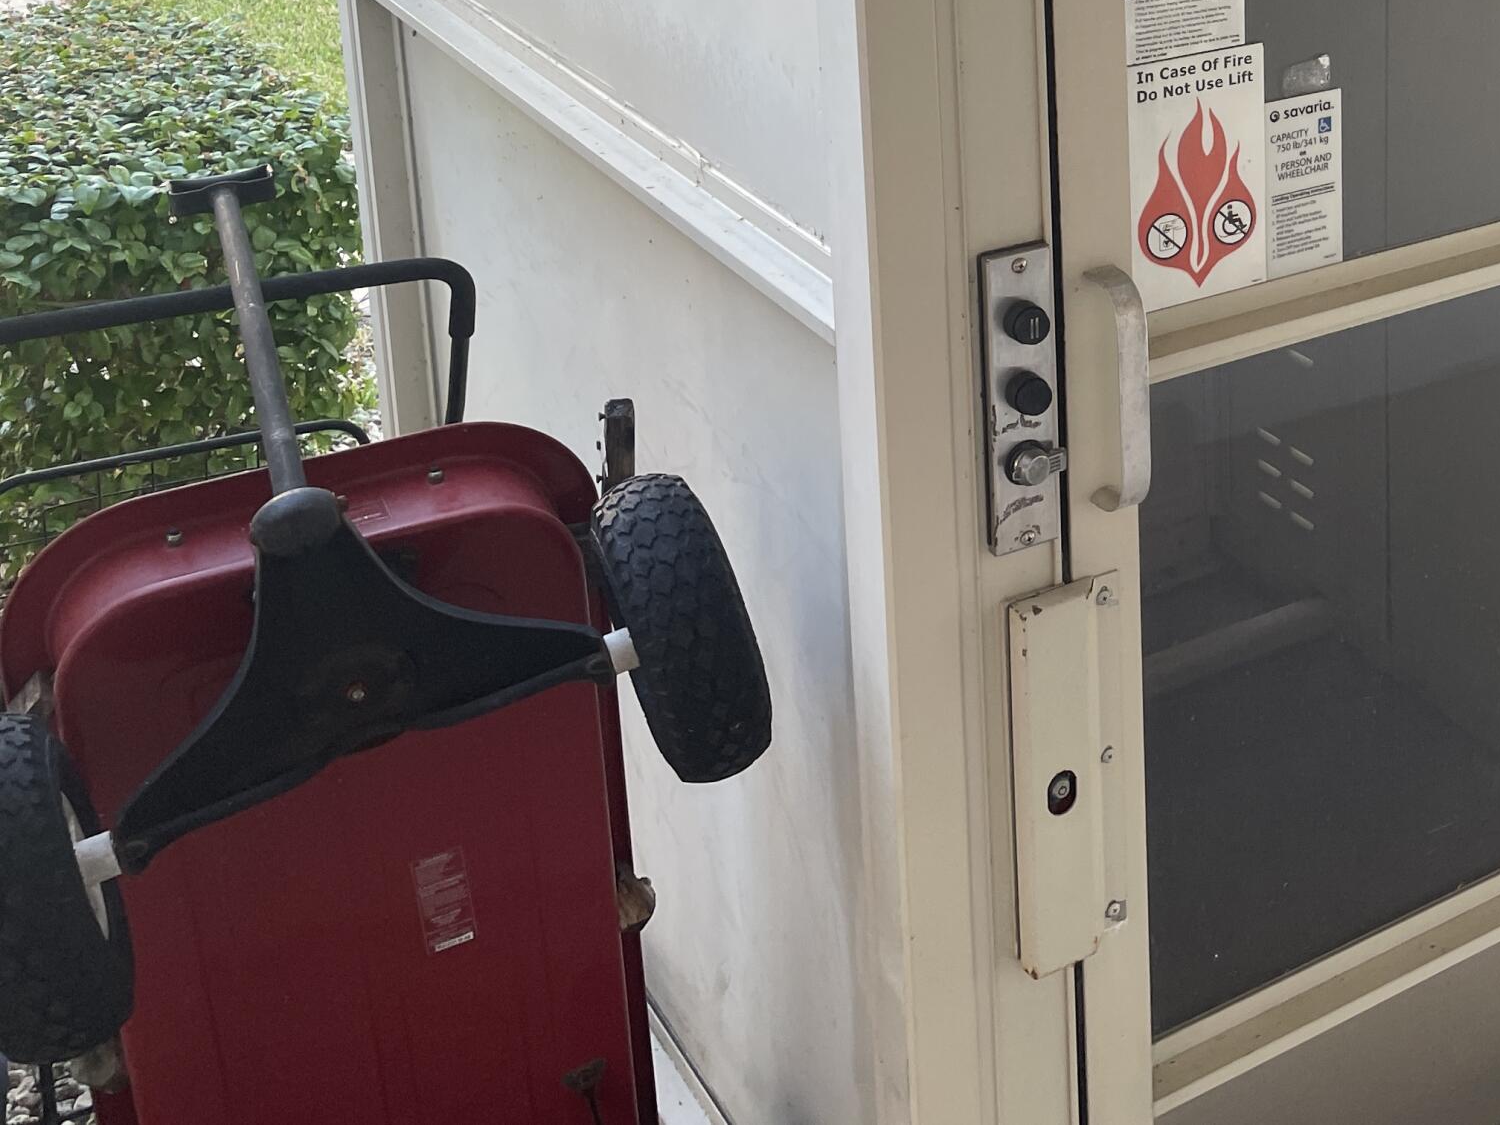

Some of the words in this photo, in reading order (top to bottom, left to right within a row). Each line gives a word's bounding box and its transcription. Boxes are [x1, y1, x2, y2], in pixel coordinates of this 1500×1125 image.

[1136, 71, 1154, 84] In
[1160, 65, 1196, 80] Case
[1202, 58, 1219, 72] Of
[1224, 55, 1252, 68] Fire
[1137, 90, 1158, 103] Do
[1163, 82, 1191, 98] Not
[1195, 78, 1223, 91] Use
[1229, 70, 1254, 85] Lift
[1283, 99, 1331, 119] savaria
[1270, 127, 1309, 144] CAPACITY
[1276, 142, 1291, 153] 750
[1292, 137, 1317, 149] lb/341
[1319, 136, 1329, 145] kg
[1280, 156, 1312, 171] PERSON
[1314, 152, 1332, 164] AND
[1278, 162, 1329, 181] WHEELCHAIR
